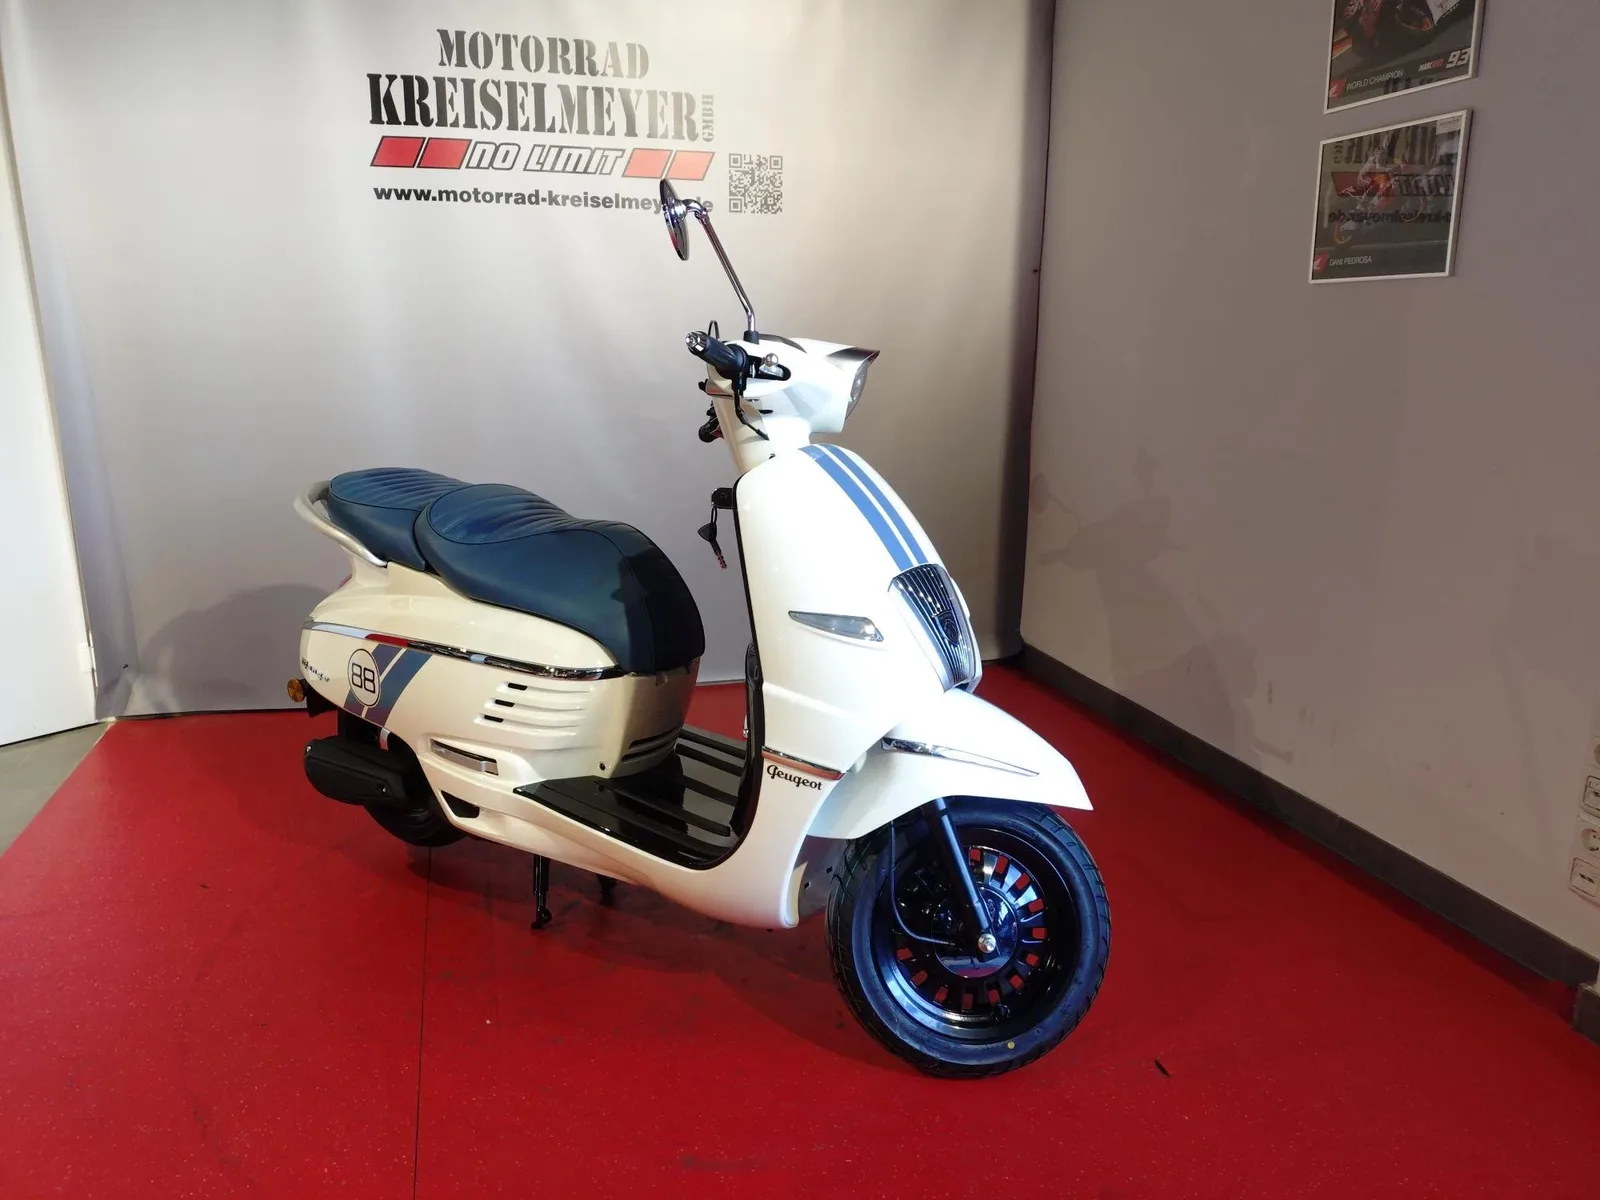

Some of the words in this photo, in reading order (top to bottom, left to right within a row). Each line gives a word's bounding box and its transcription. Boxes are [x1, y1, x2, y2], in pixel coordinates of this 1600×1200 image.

[436, 29, 650, 79] MOTORRAD
[1445, 48, 1471, 68] 93
[1346, 78, 1369, 91] WORLD
[1369, 69, 1405, 85] CHAMPION
[366, 73, 700, 142] KREISELMEYER
[702, 94, 715, 142] GMBH
[373, 187, 714, 215] www.motorrad-kreiselmeye
[1329, 258, 1343, 266] DANI
[1344, 256, 1372, 265] PEDROSA
[352, 662, 376, 694] 88
[766, 764, 823, 790] Peugeot
